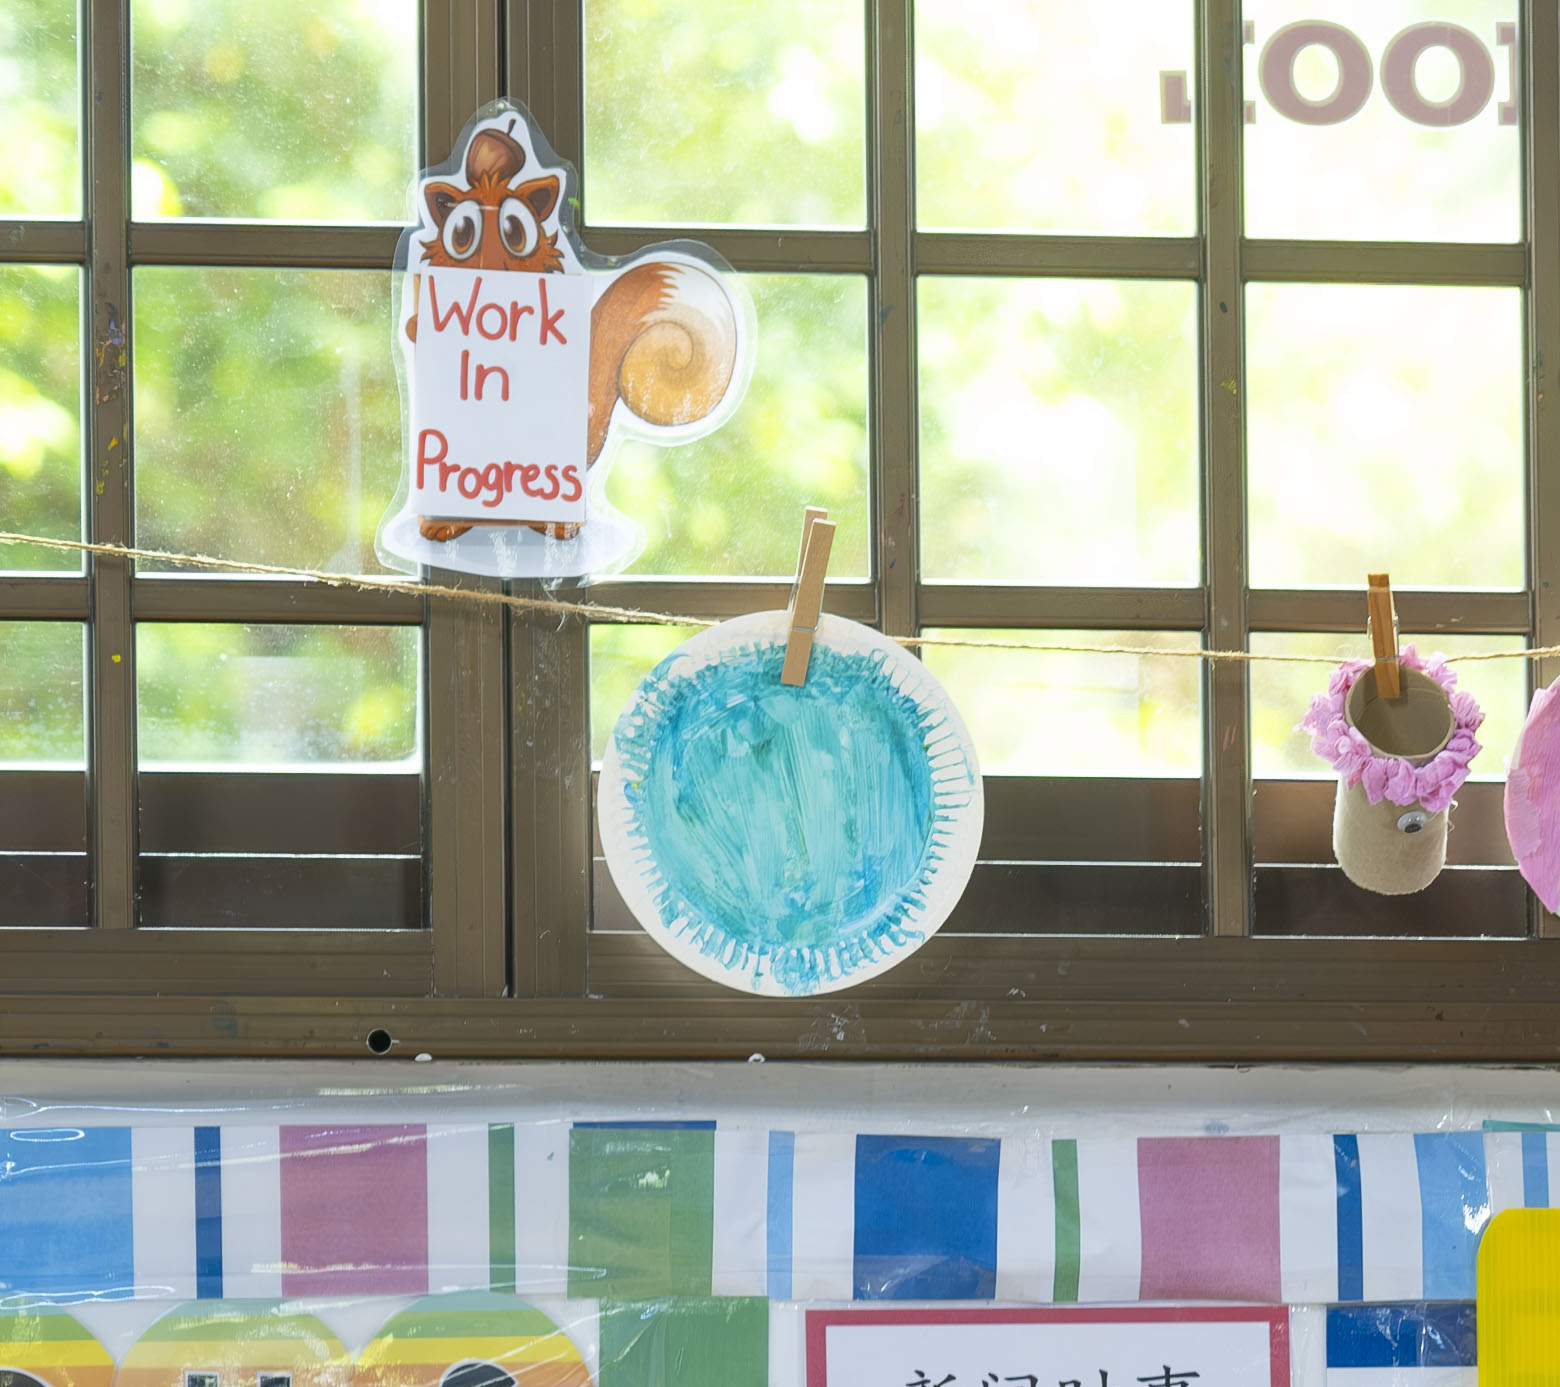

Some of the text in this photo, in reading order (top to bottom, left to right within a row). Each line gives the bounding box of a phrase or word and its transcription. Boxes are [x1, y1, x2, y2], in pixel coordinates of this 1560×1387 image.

[428, 273, 568, 346] Work
[458, 349, 511, 402] In
[415, 428, 583, 508] Progress
